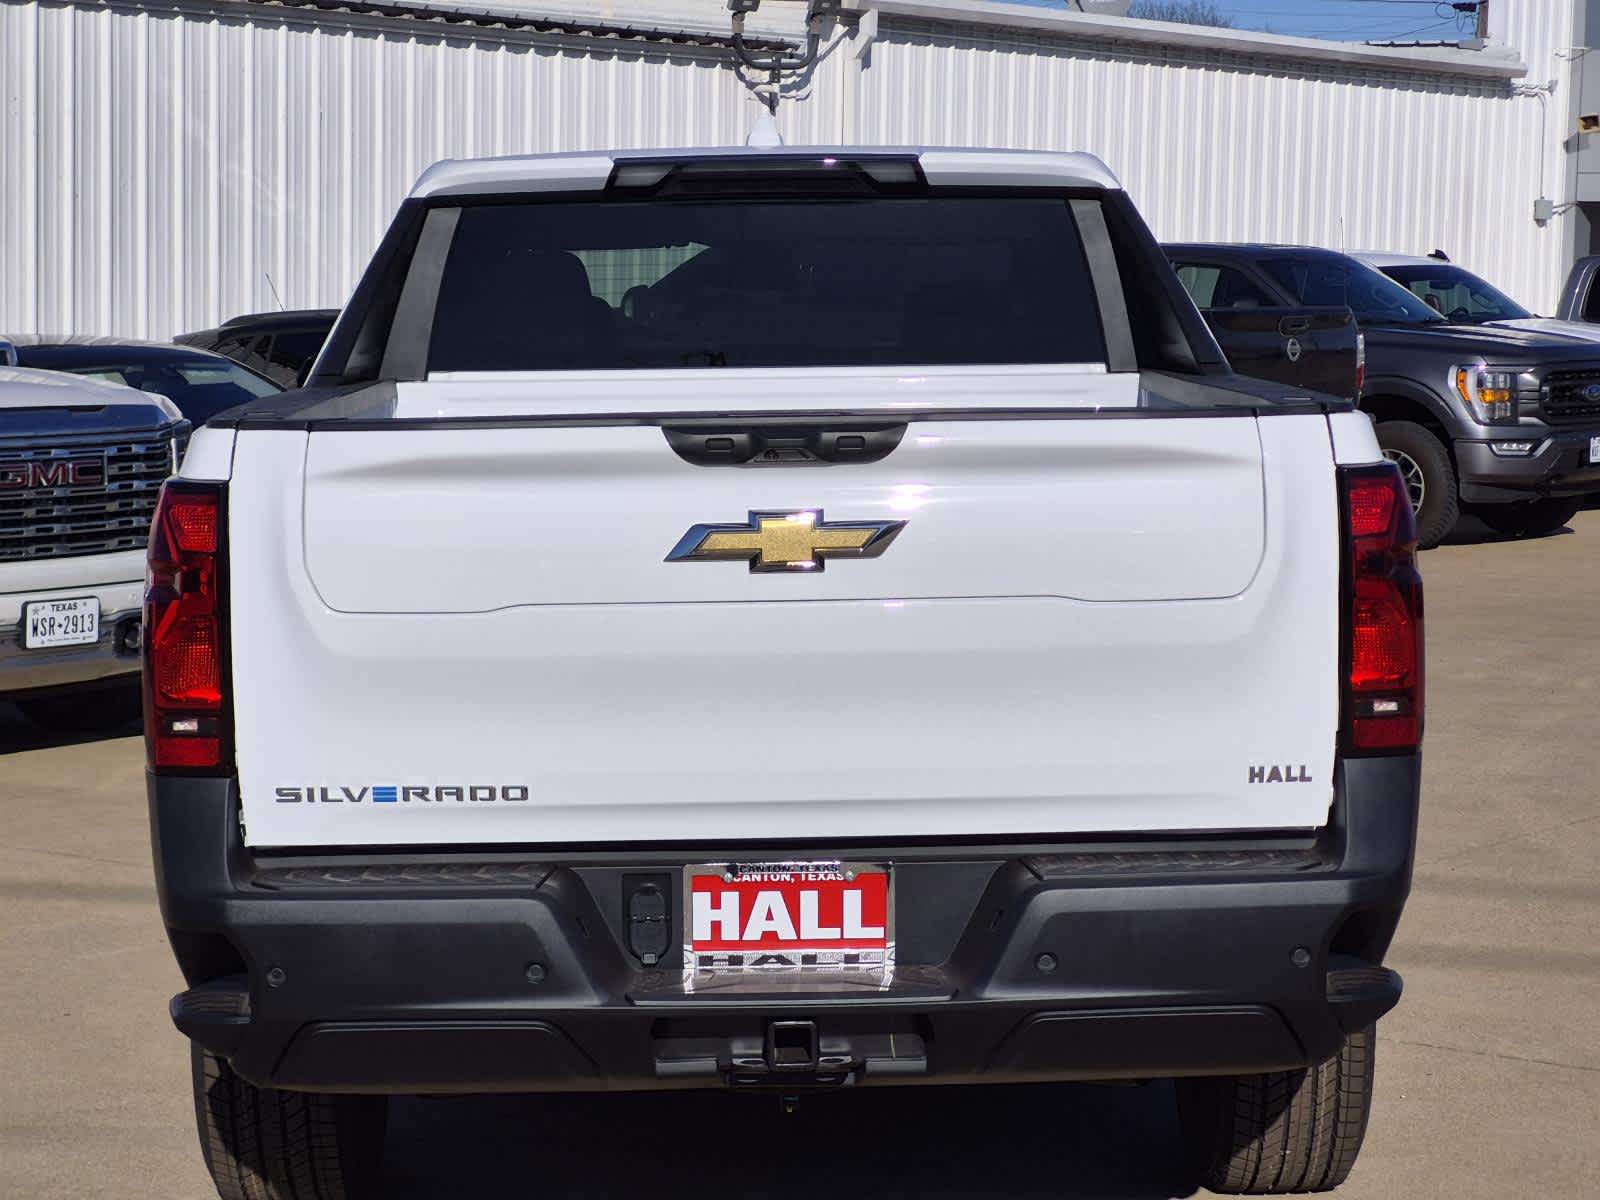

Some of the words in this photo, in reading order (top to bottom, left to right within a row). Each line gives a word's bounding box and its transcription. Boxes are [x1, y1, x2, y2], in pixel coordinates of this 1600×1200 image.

[0, 460, 101, 488] GMC
[51, 602, 78, 612] TEXAS
[1248, 764, 1312, 783] HALL
[275, 785, 529, 803] SILVERADO
[692, 889, 885, 941] HALL
